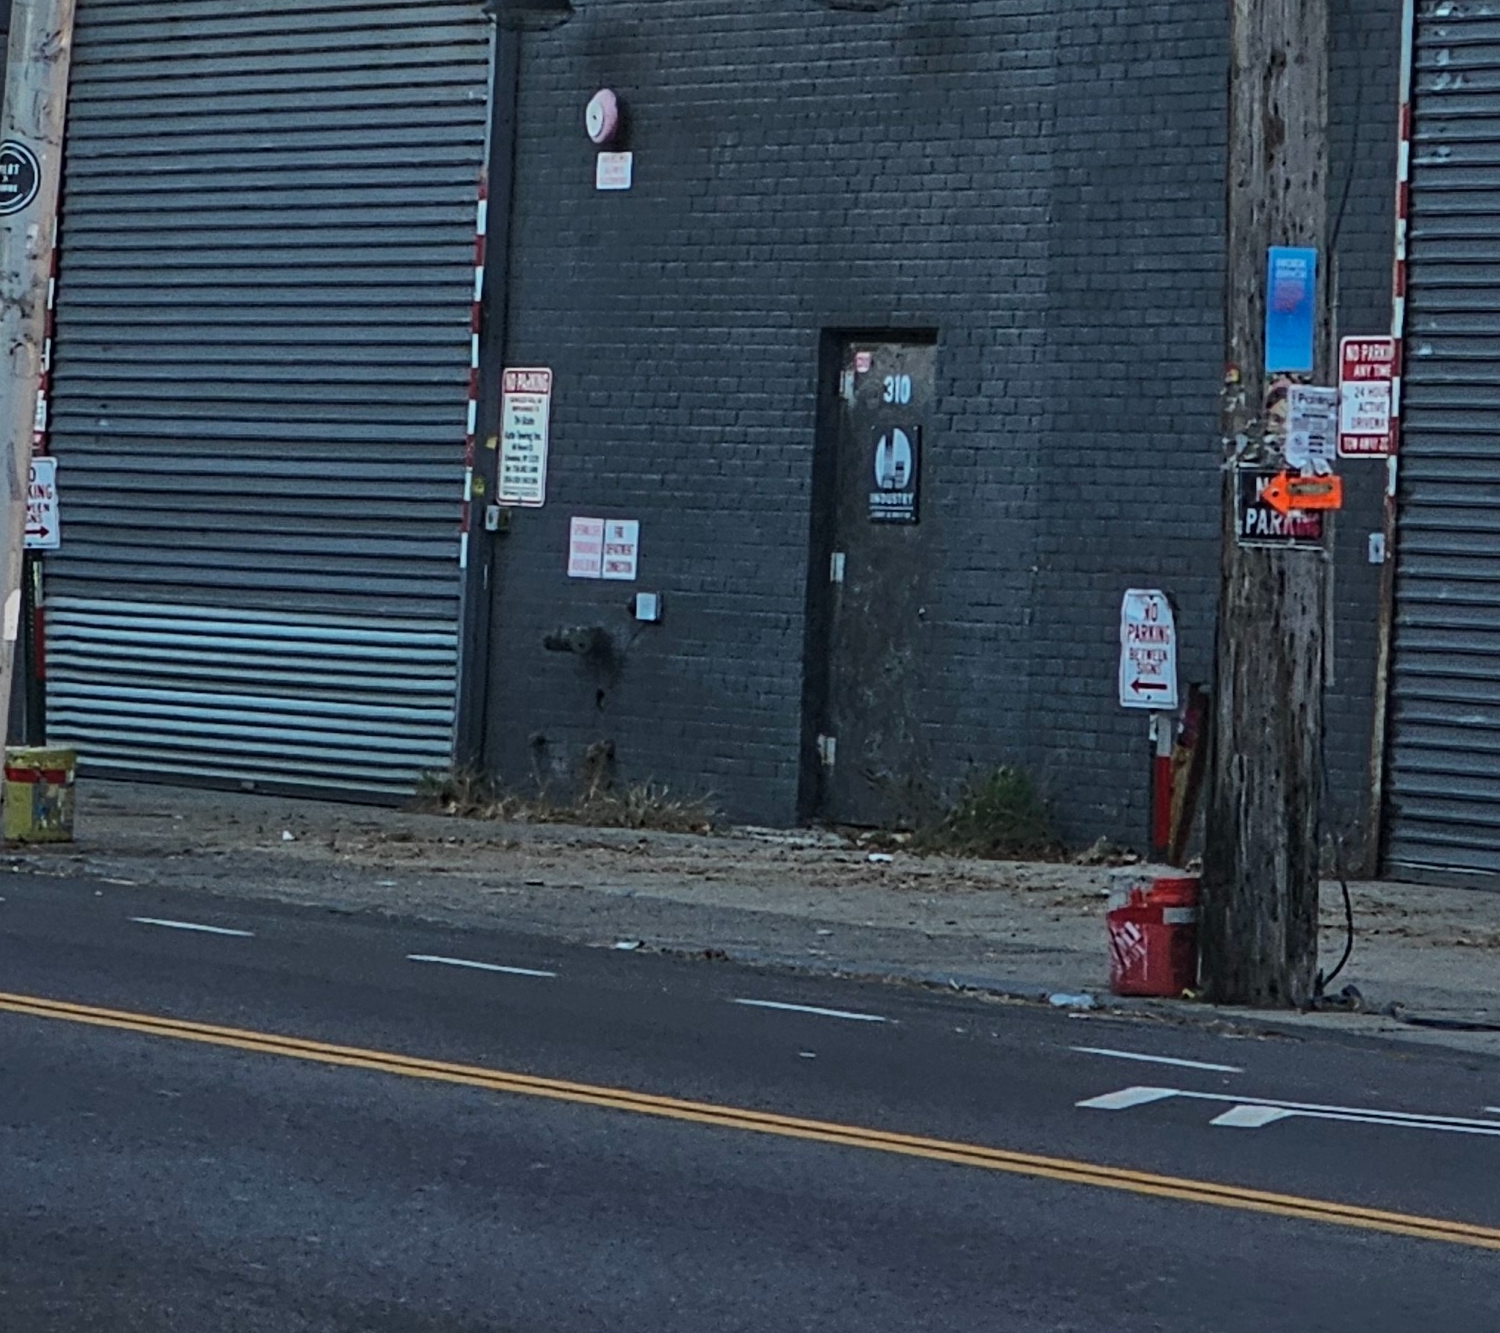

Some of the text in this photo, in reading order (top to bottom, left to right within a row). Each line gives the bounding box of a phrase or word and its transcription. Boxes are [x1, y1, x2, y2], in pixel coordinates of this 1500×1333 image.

[1346, 343, 1359, 361] NO
[1353, 363, 1372, 378] ANY
[505, 372, 549, 393] NO PARKING
[883, 373, 912, 404] 310
[1144, 602, 1158, 622] NO
[1127, 624, 1171, 645] PARKING
